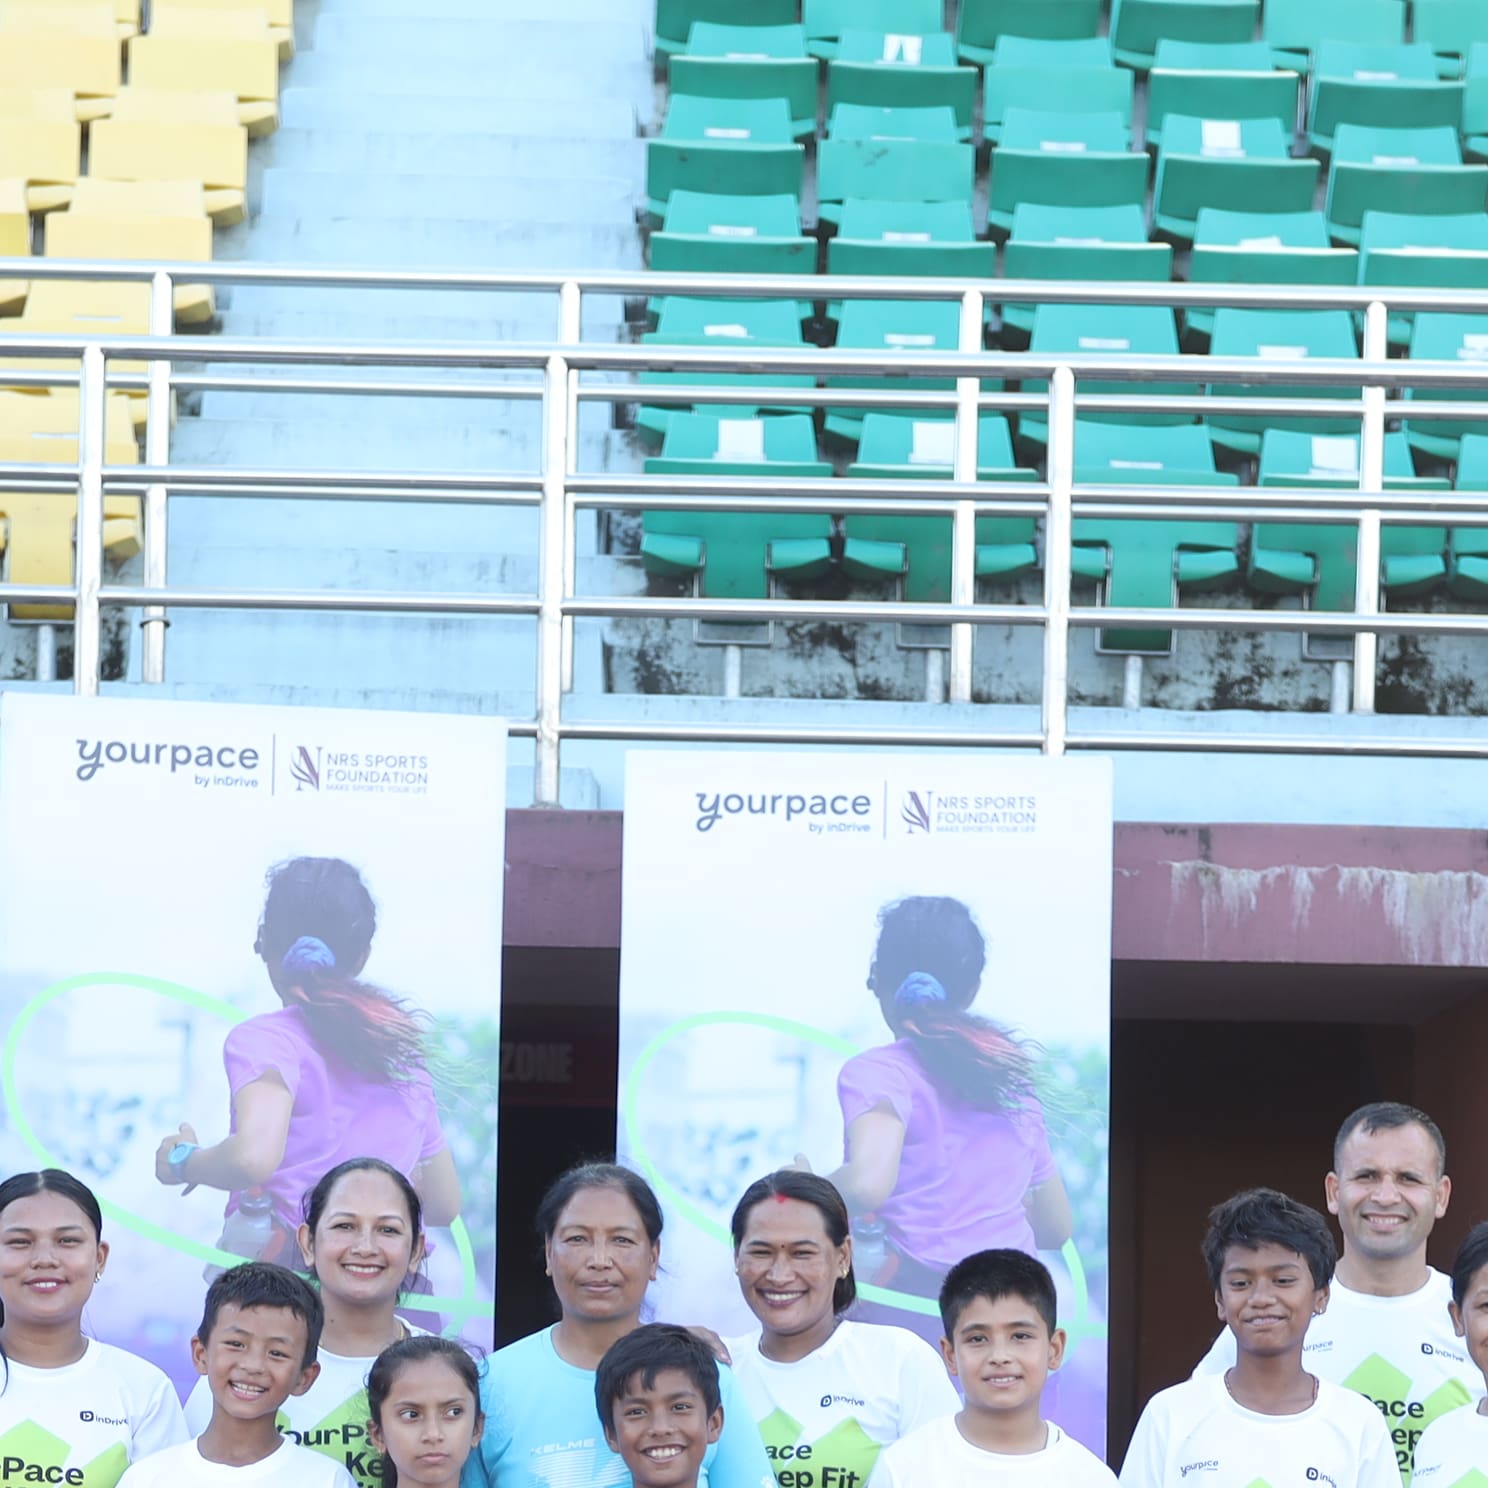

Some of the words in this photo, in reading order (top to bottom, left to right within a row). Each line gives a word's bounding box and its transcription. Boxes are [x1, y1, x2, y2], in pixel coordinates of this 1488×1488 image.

[76, 739, 259, 781] yourpace
[327, 753, 360, 766] NRS
[365, 755, 428, 769] SPORTS
[195, 776, 210, 788] by
[214, 776, 258, 787] inDrive
[327, 769, 428, 784] FOUNDATION
[937, 797, 968, 809] NRS
[975, 797, 1036, 809] SPORTS
[696, 792, 871, 832] yourpace
[937, 812, 1036, 824] FOUNDATION
[809, 823, 823, 834] by
